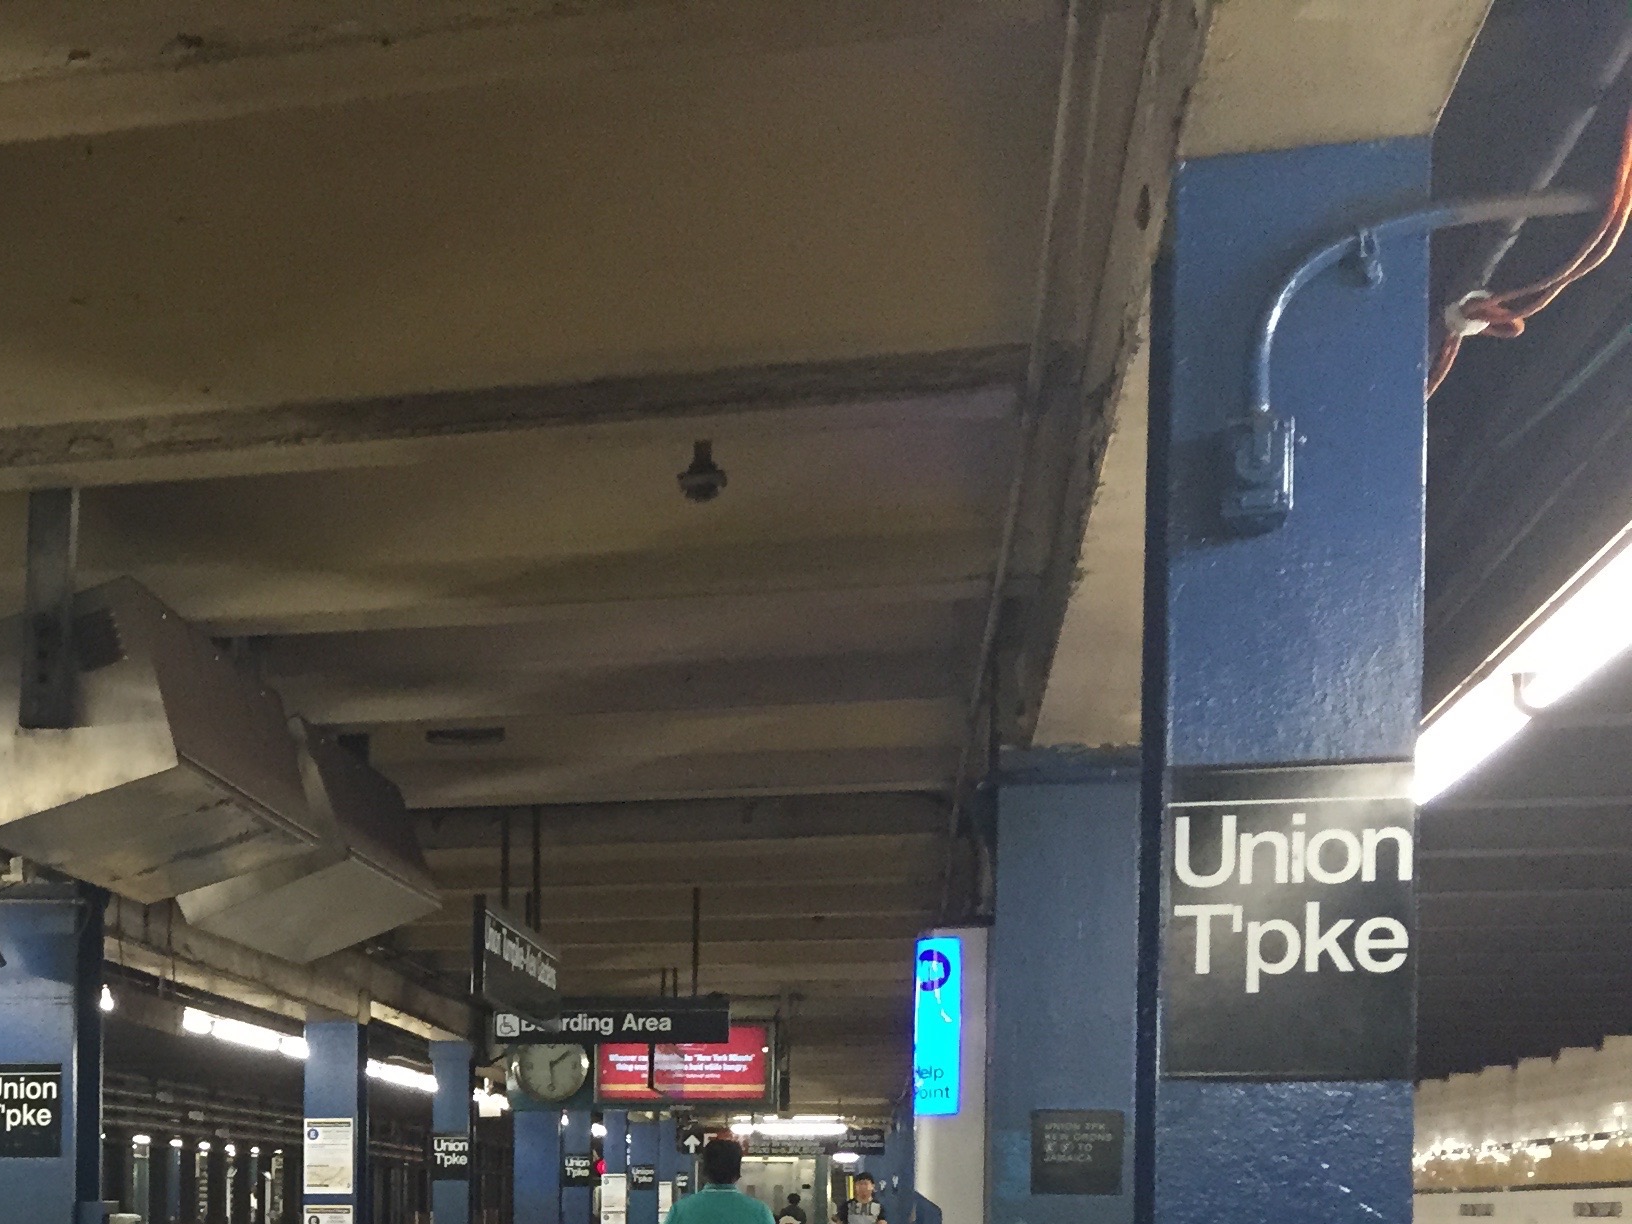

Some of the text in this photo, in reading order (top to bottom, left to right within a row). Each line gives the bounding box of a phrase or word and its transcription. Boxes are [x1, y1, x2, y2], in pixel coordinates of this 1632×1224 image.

[1175, 813, 1413, 888] Union
[1174, 901, 1409, 993] T'pke
[521, 1013, 671, 1035] Brding Area
[916, 1086, 950, 1099] oint
[434, 1139, 468, 1151] Union
[565, 1157, 590, 1167] Union
